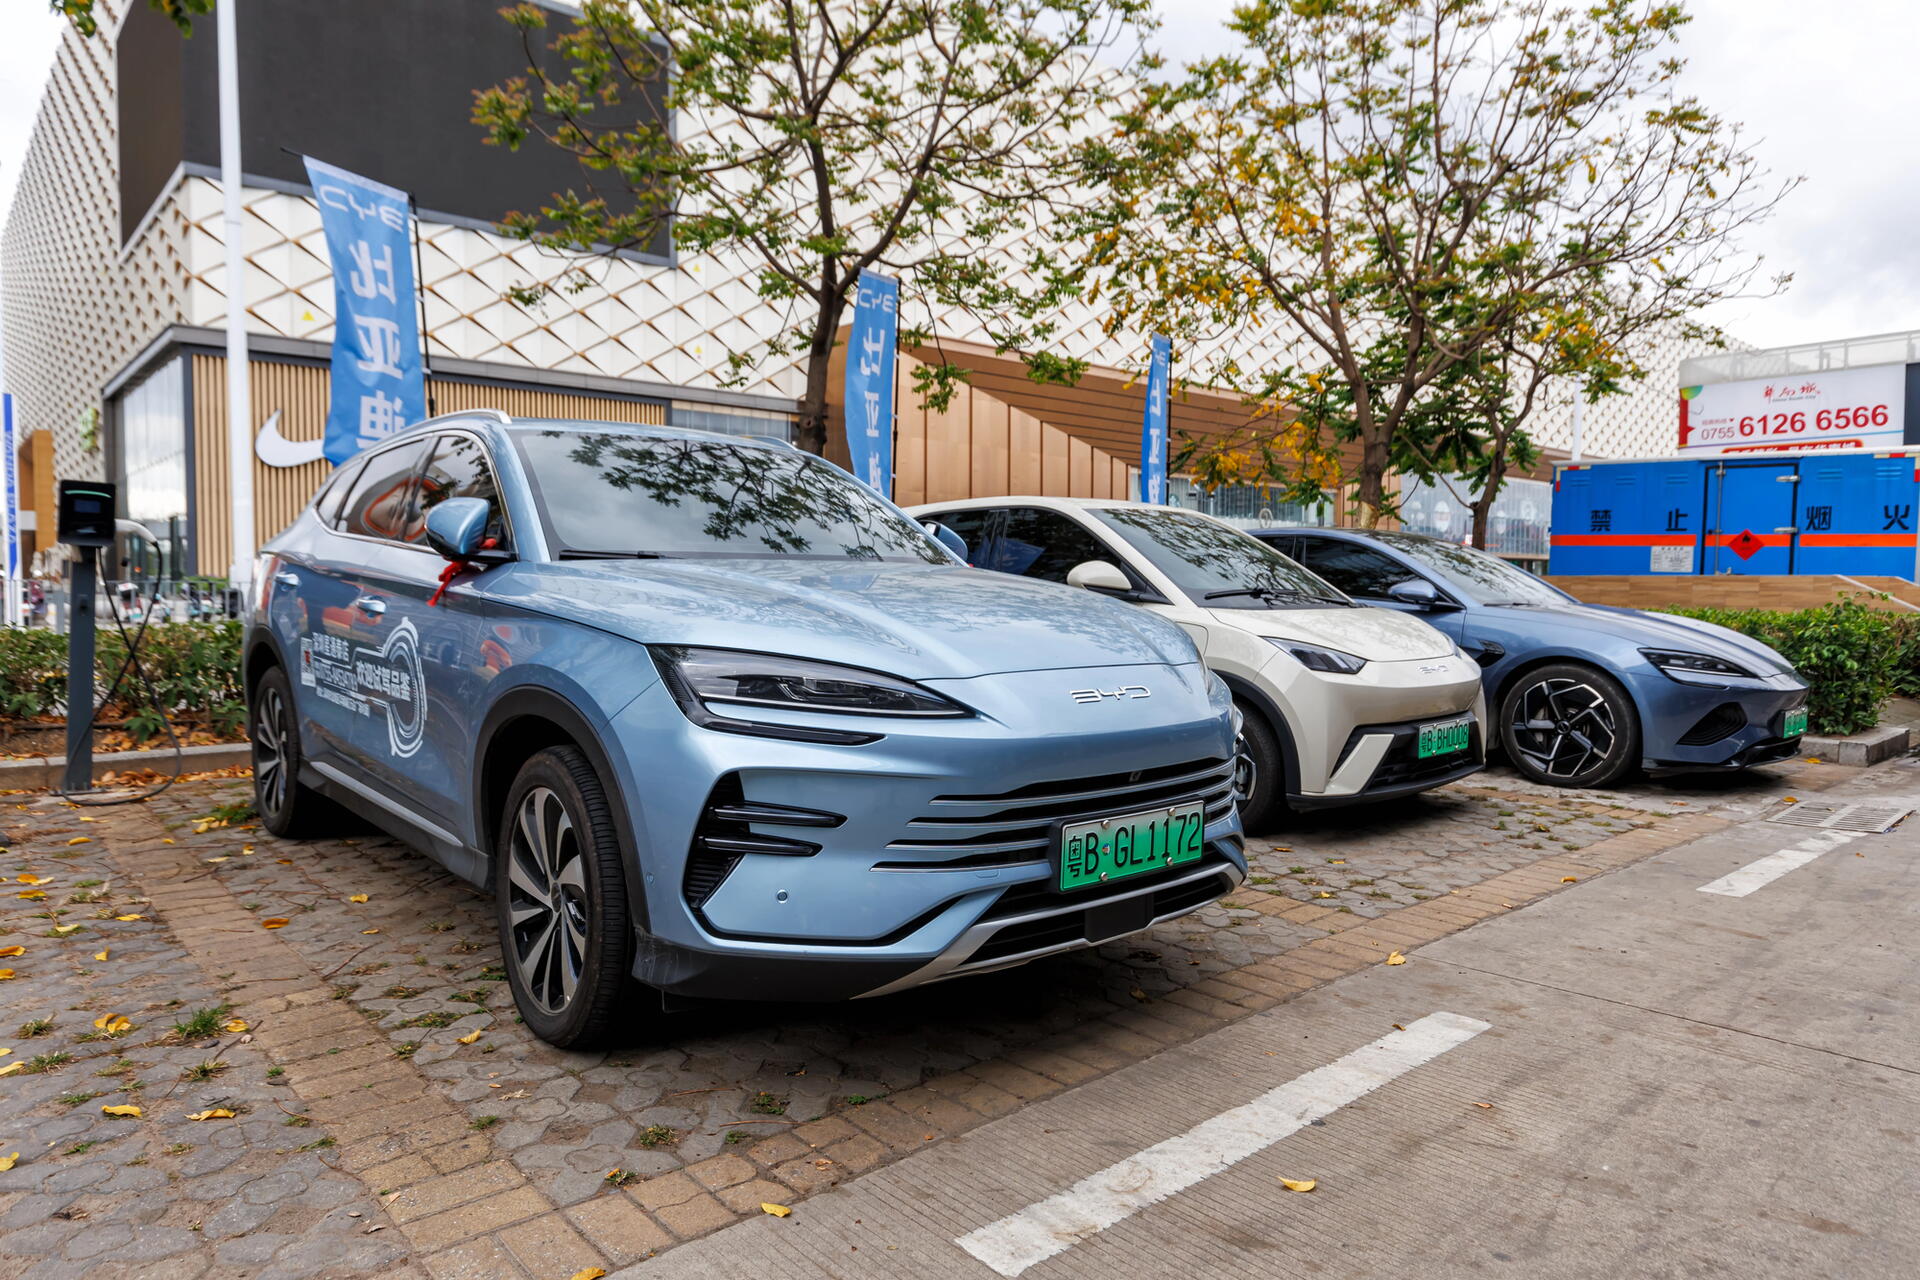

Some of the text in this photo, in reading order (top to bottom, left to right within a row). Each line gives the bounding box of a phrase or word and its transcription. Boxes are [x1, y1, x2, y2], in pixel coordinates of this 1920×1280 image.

[1701, 404, 1889, 441] 0755 6126 6566
[1069, 684, 1152, 705] BYD
